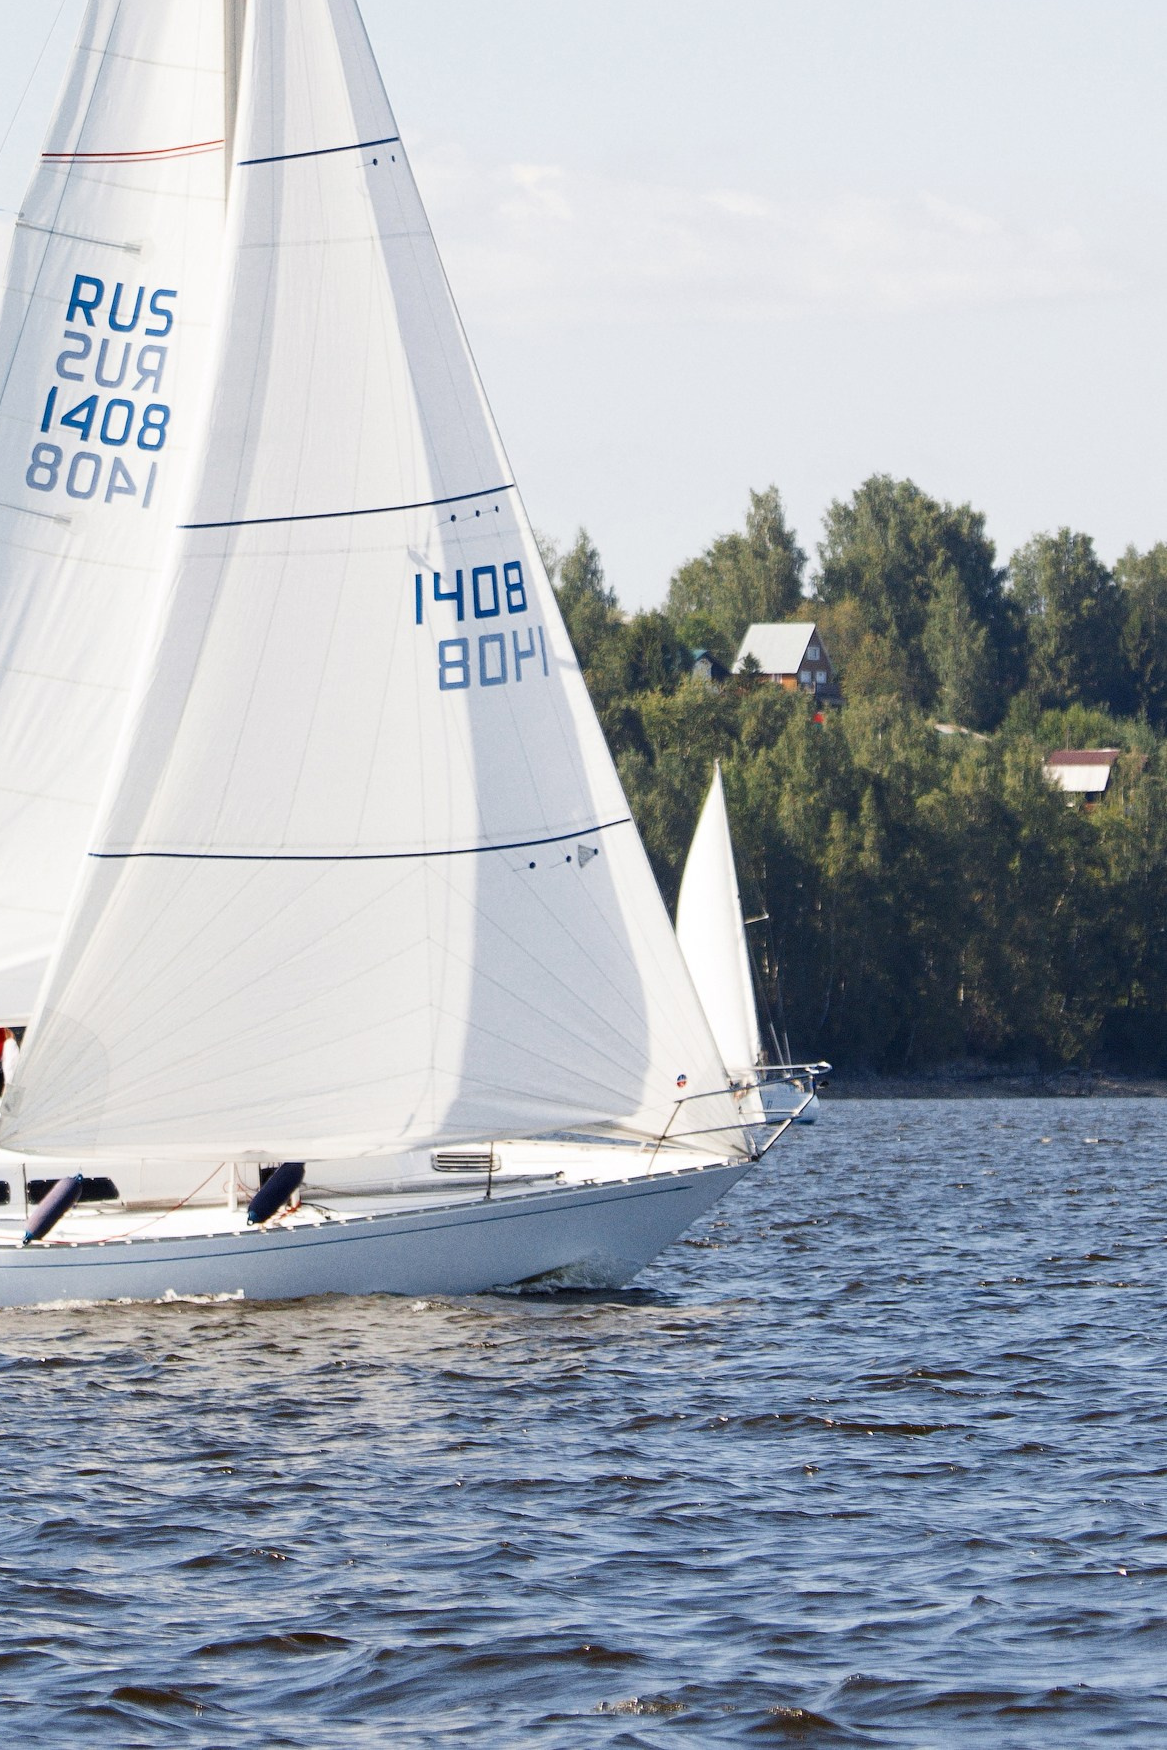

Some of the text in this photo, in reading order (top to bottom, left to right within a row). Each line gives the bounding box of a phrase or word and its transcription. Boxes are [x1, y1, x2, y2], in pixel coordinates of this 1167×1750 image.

[65, 273, 178, 338] RUS
[40, 385, 171, 452] 1408
[415, 560, 528, 626] 1408
